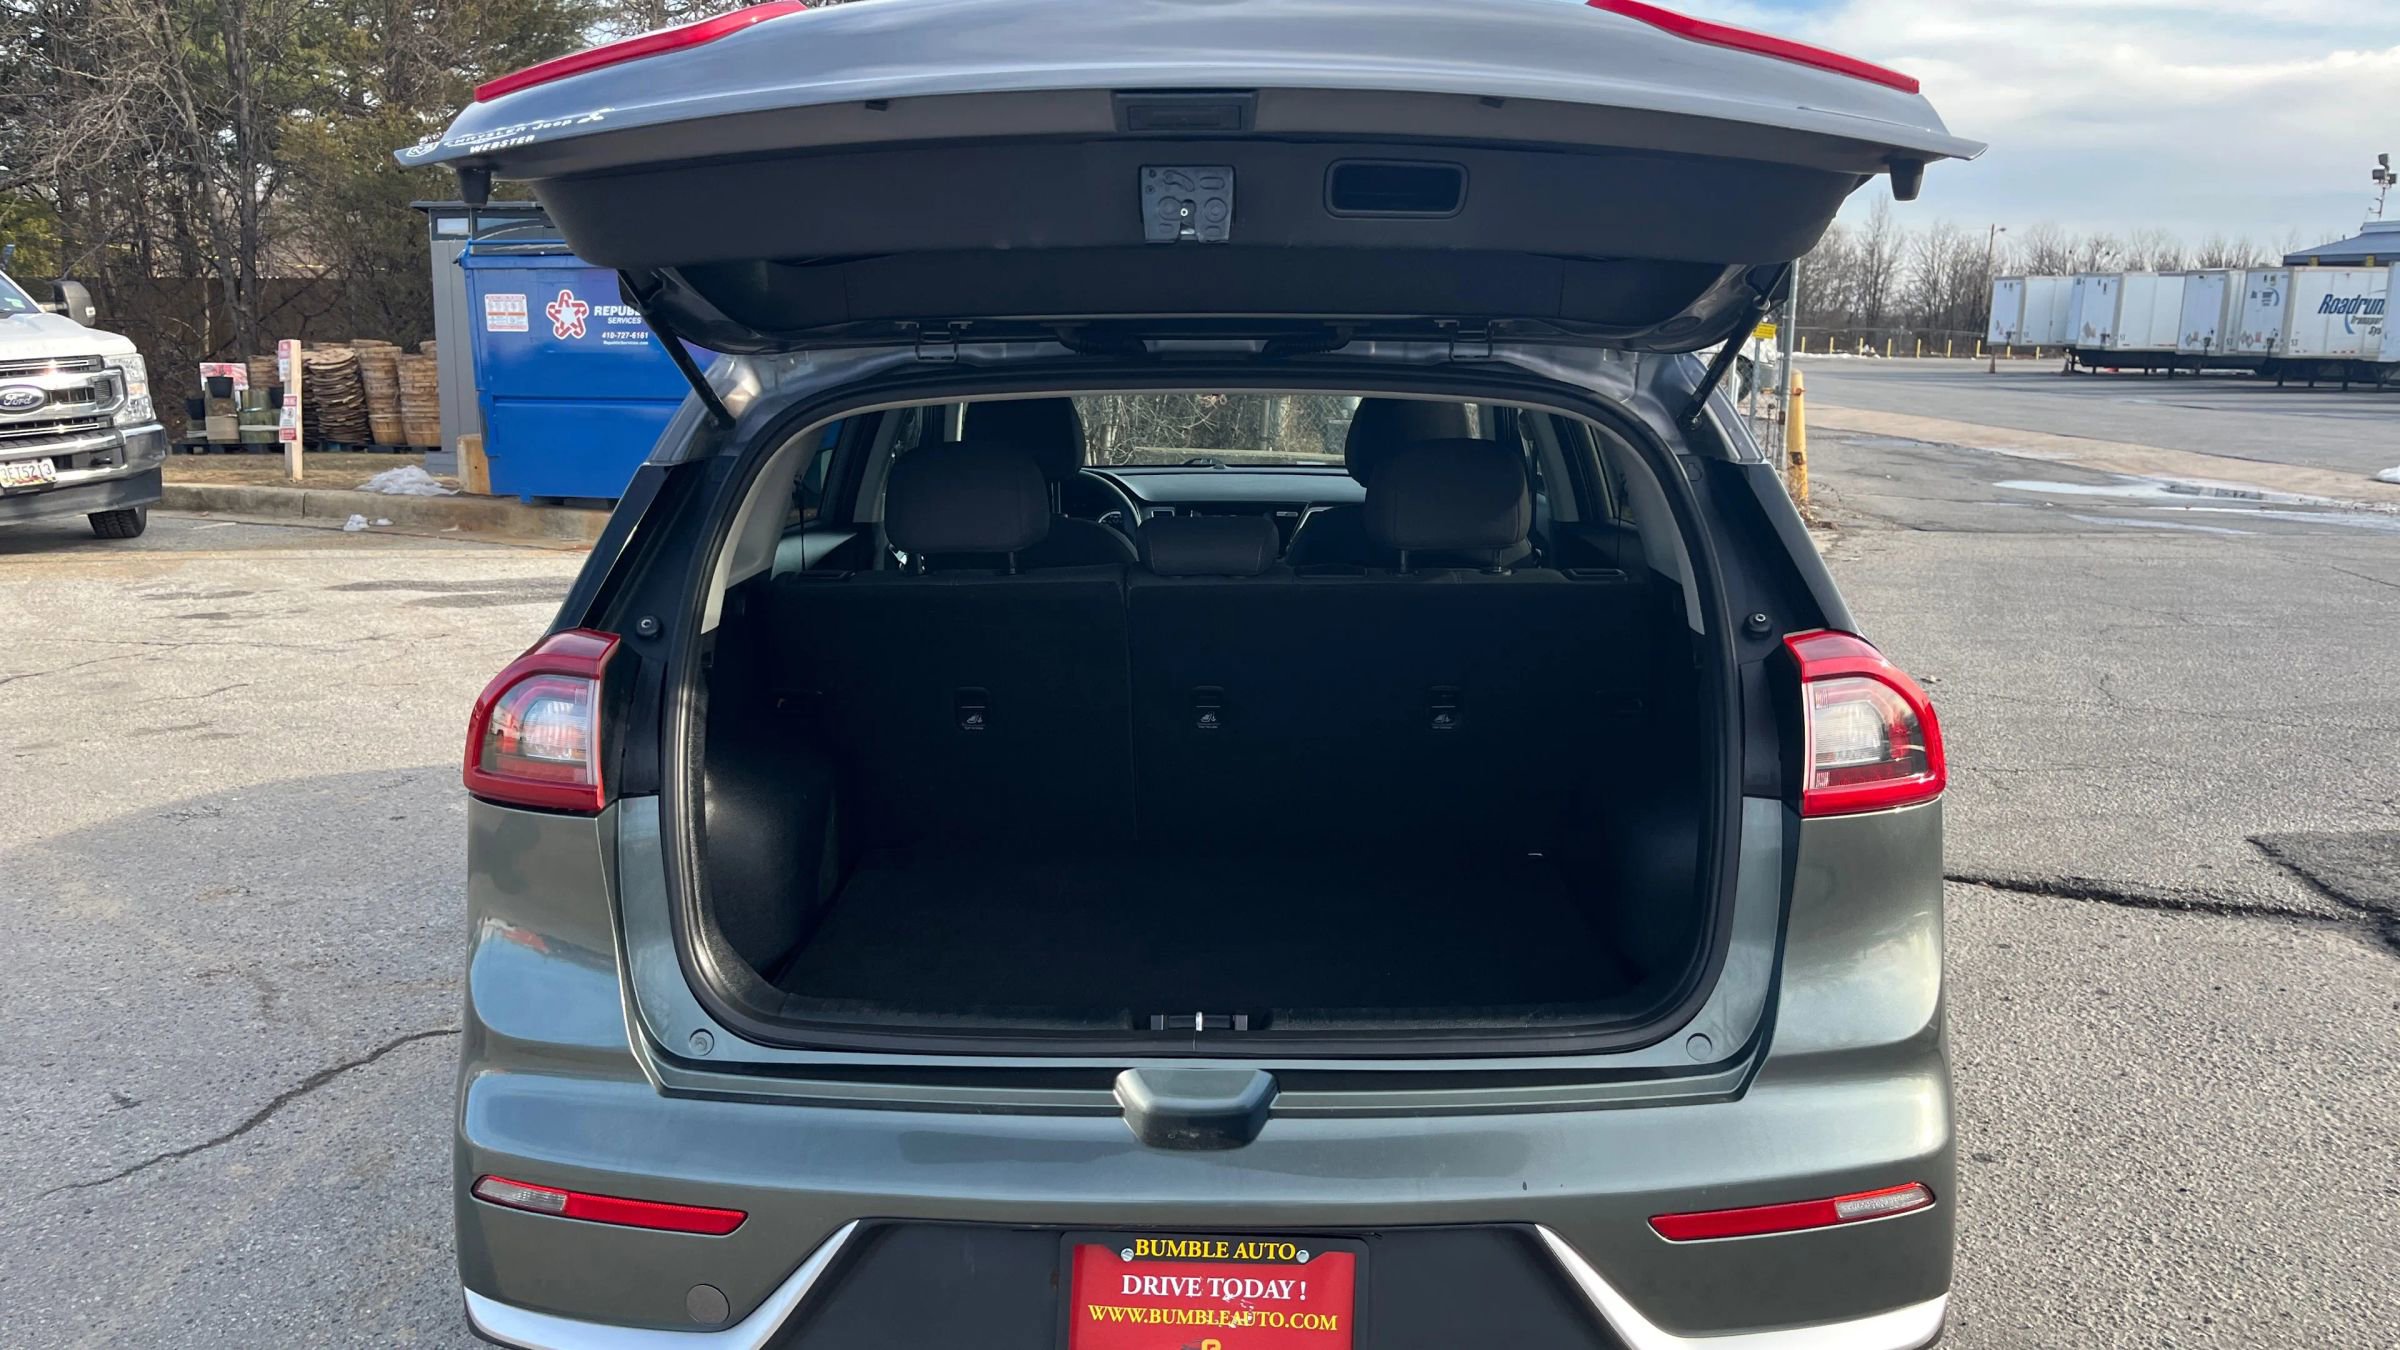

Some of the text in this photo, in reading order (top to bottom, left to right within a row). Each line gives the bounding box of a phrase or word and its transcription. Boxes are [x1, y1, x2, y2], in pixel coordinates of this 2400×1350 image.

[532, 119, 572, 130] Jeep
[469, 134, 536, 153] WEBSTER
[607, 317, 642, 325] SERVICES
[602, 331, 649, 339] 410-727-6161
[3, 391, 33, 406] Ford
[1135, 1238, 1297, 1261] BUMBLE AUTO
[1121, 1274, 1203, 1298] DRIVE
[1207, 1276, 1296, 1300] TODAY
[1088, 1304, 1338, 1331] WWW.BUMBLEAUTO.COM
